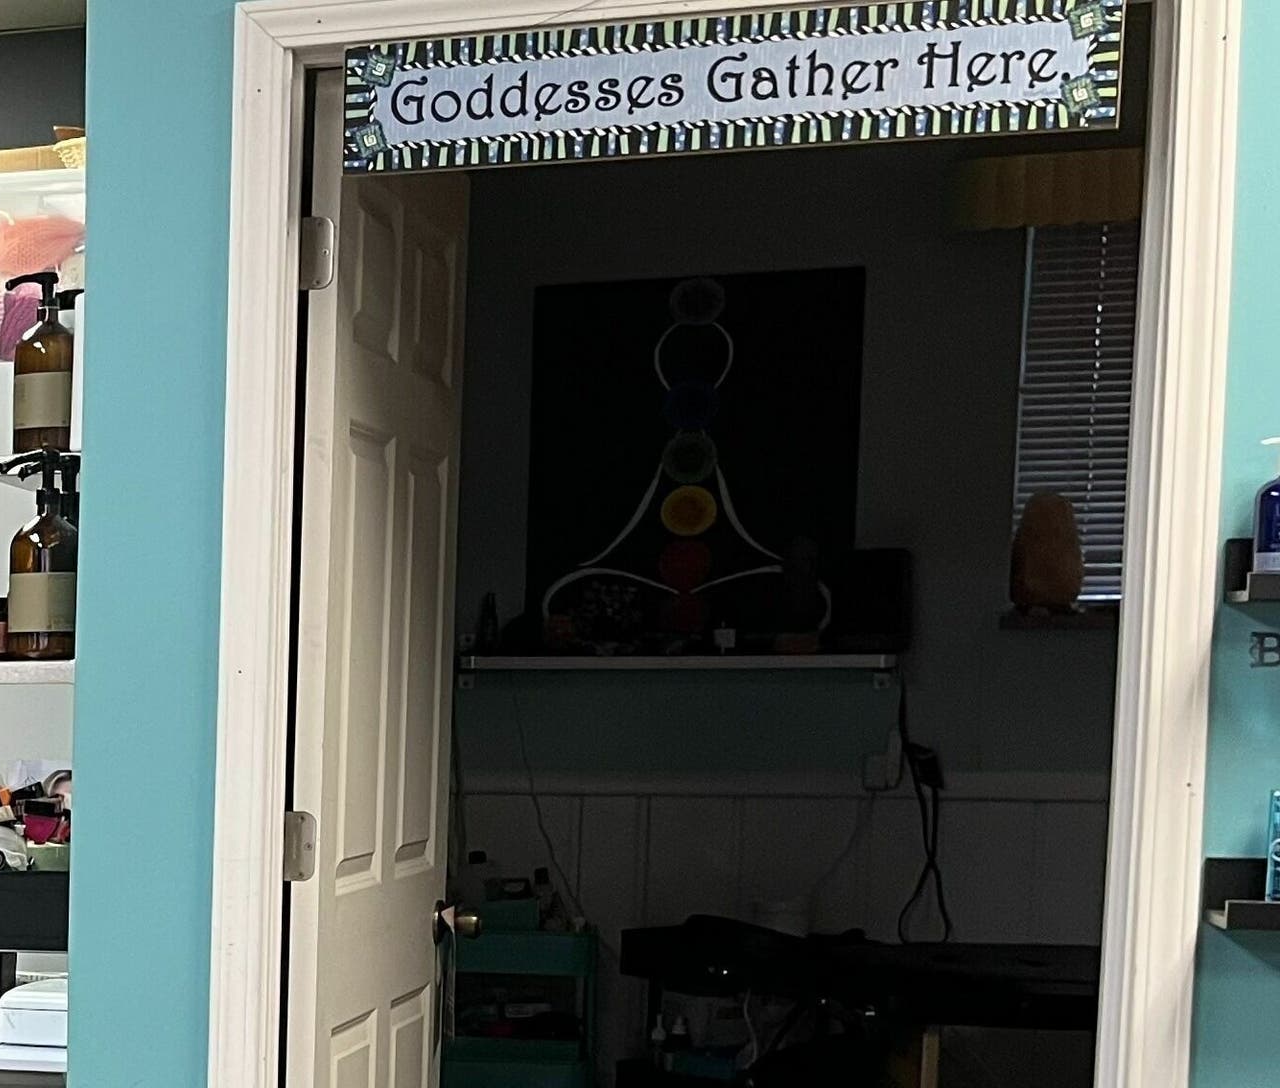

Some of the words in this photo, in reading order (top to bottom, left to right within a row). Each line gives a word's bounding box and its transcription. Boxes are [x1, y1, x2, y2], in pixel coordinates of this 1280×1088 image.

[391, 70, 684, 125] Goddesses
[707, 51, 899, 103] Gather
[918, 40, 1070, 93] Here.
